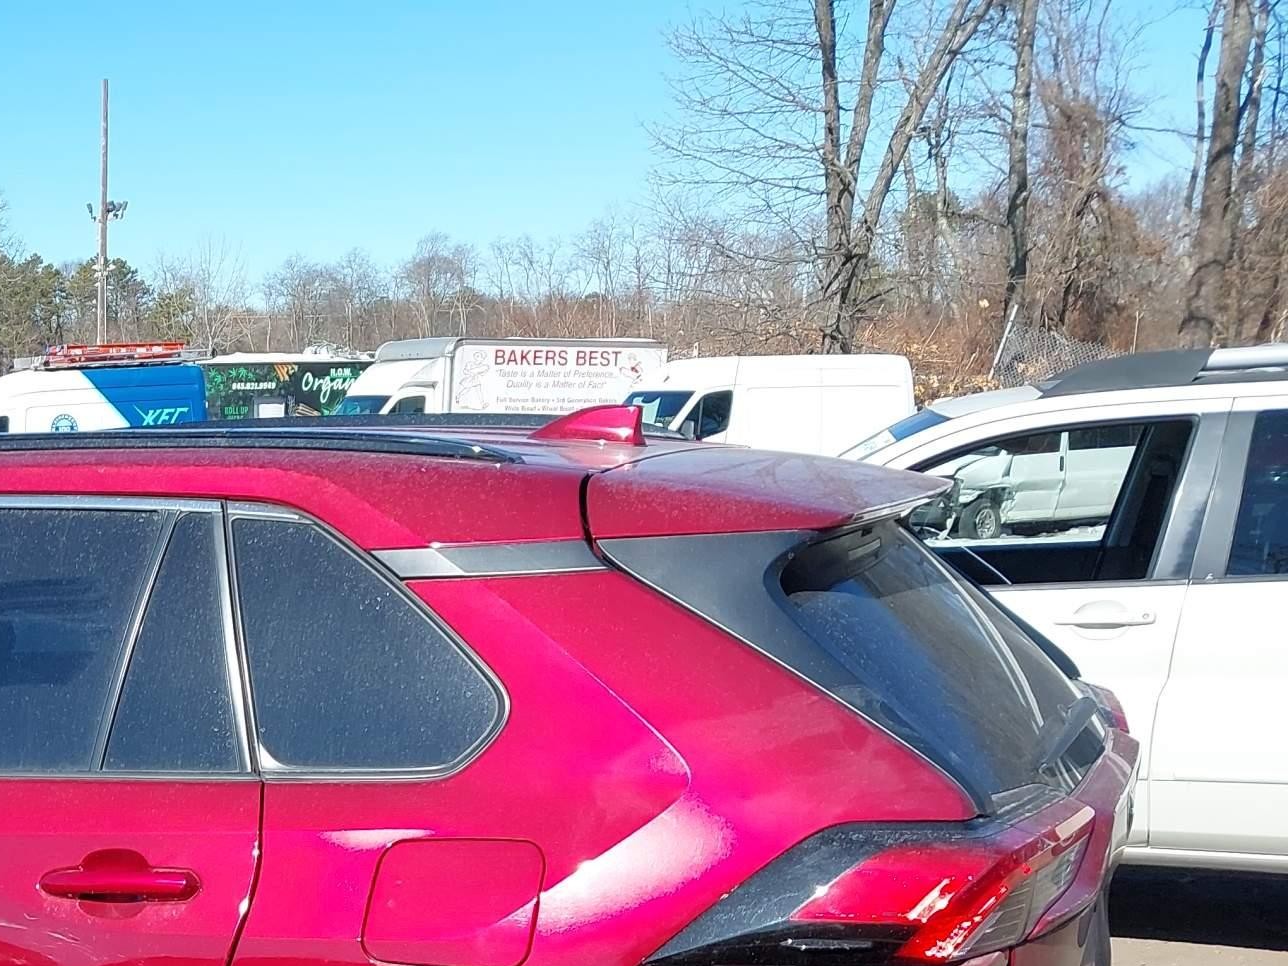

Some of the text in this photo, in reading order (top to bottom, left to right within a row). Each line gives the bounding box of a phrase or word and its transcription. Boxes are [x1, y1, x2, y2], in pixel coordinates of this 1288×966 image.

[494, 349, 622, 367] BAKERS BEST
[302, 371, 361, 403] Organ
